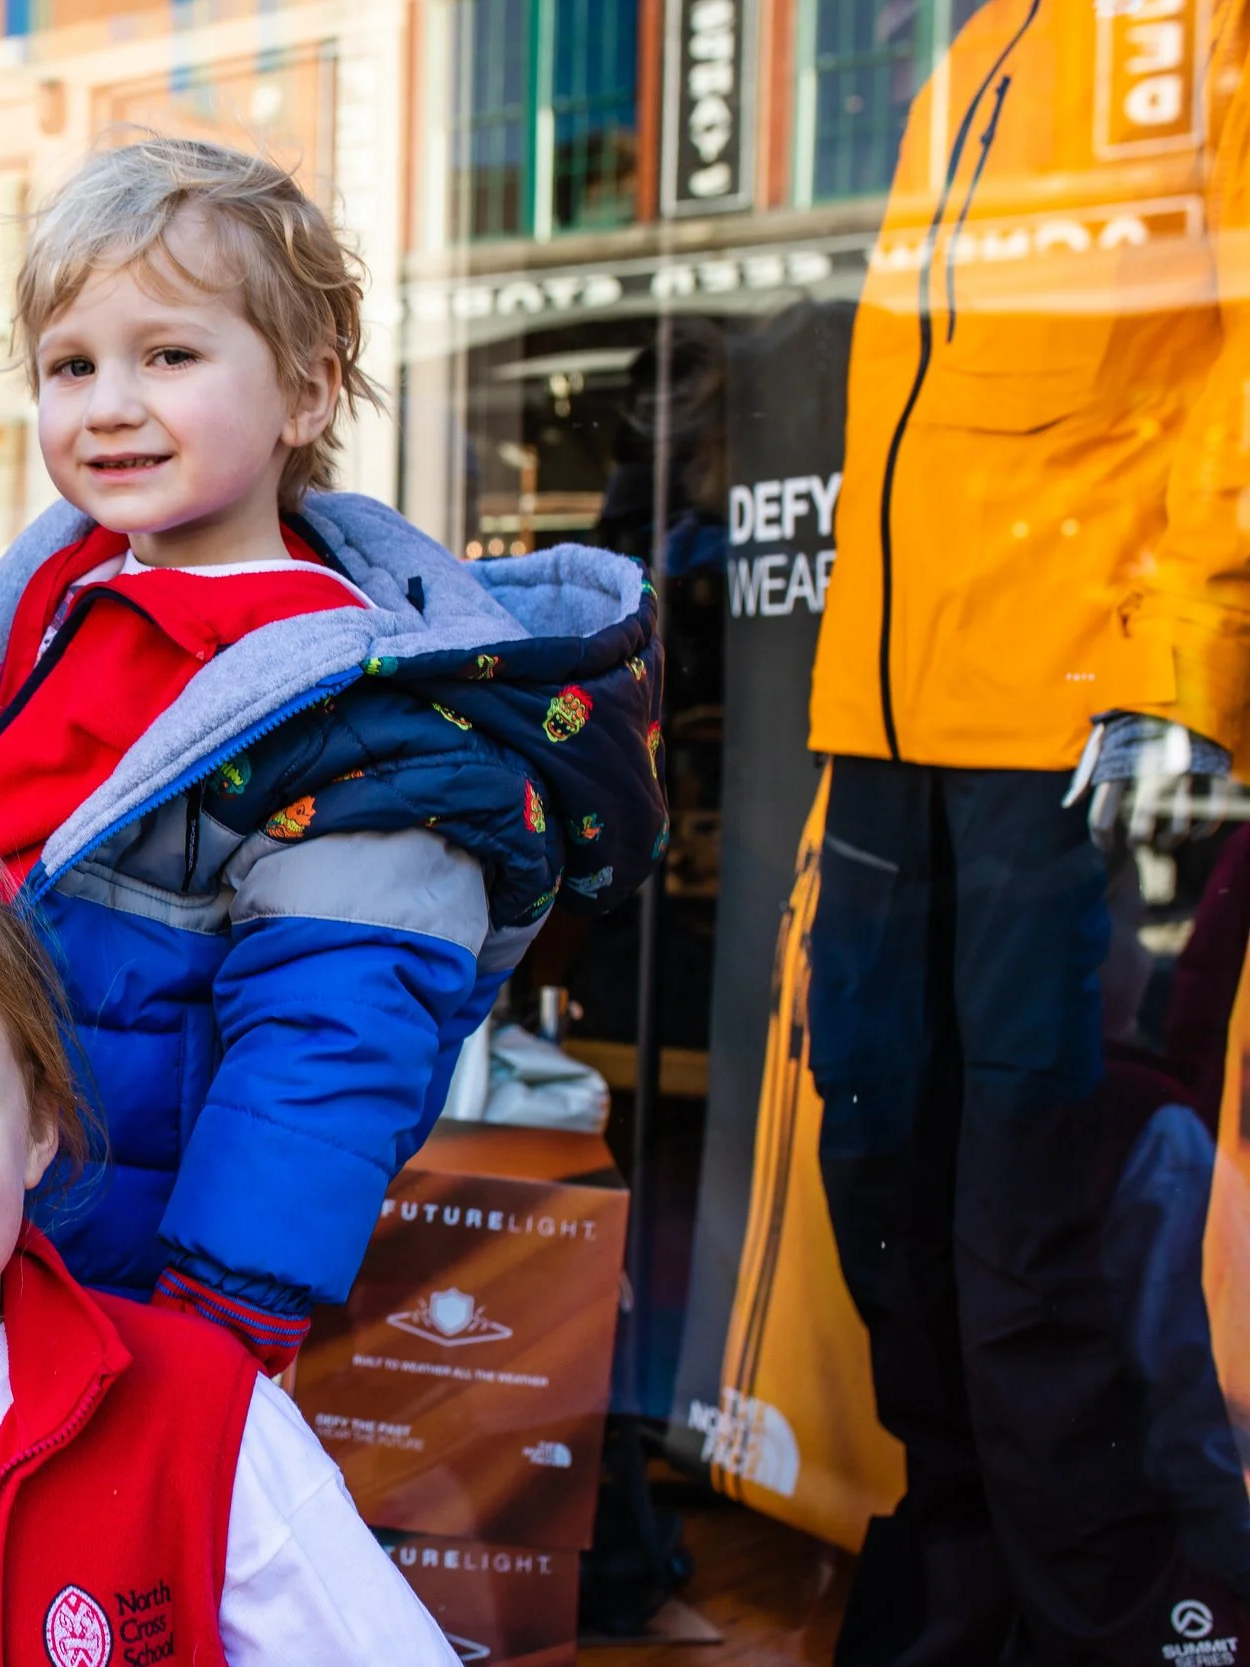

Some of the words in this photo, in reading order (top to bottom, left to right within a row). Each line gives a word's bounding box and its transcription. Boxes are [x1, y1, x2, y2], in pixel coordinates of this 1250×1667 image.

[729, 472, 843, 546] DEFY
[114, 1580, 171, 1616] North
[119, 1614, 167, 1643] Cross
[123, 1631, 174, 1667] School
[1162, 1636, 1238, 1659] SUMMIT
